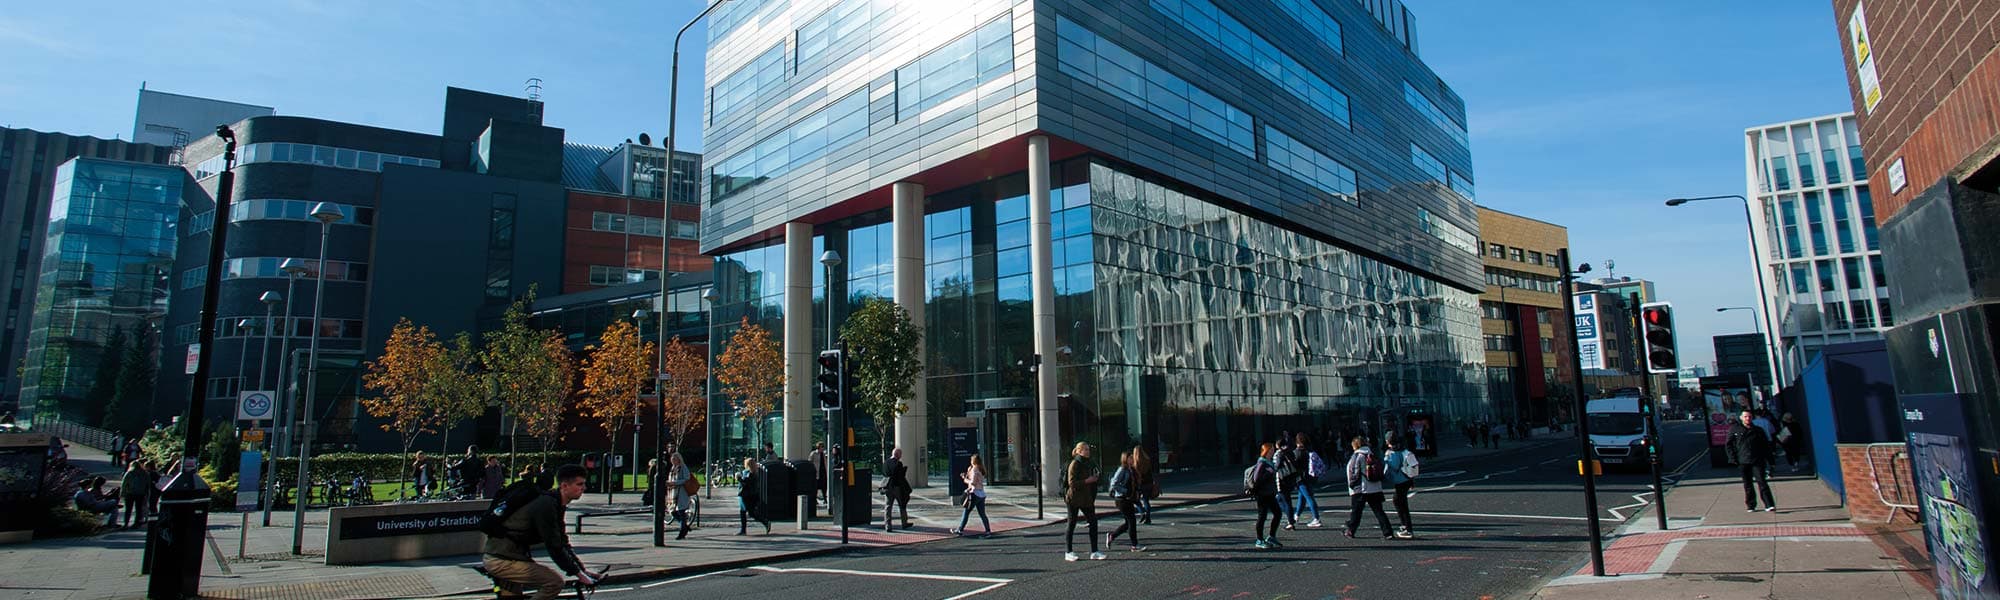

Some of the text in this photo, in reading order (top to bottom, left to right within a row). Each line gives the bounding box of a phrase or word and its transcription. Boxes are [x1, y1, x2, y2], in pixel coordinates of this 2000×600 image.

[1575, 316, 1590, 327] UK
[377, 518, 425, 530] University
[428, 517, 438, 528] of
